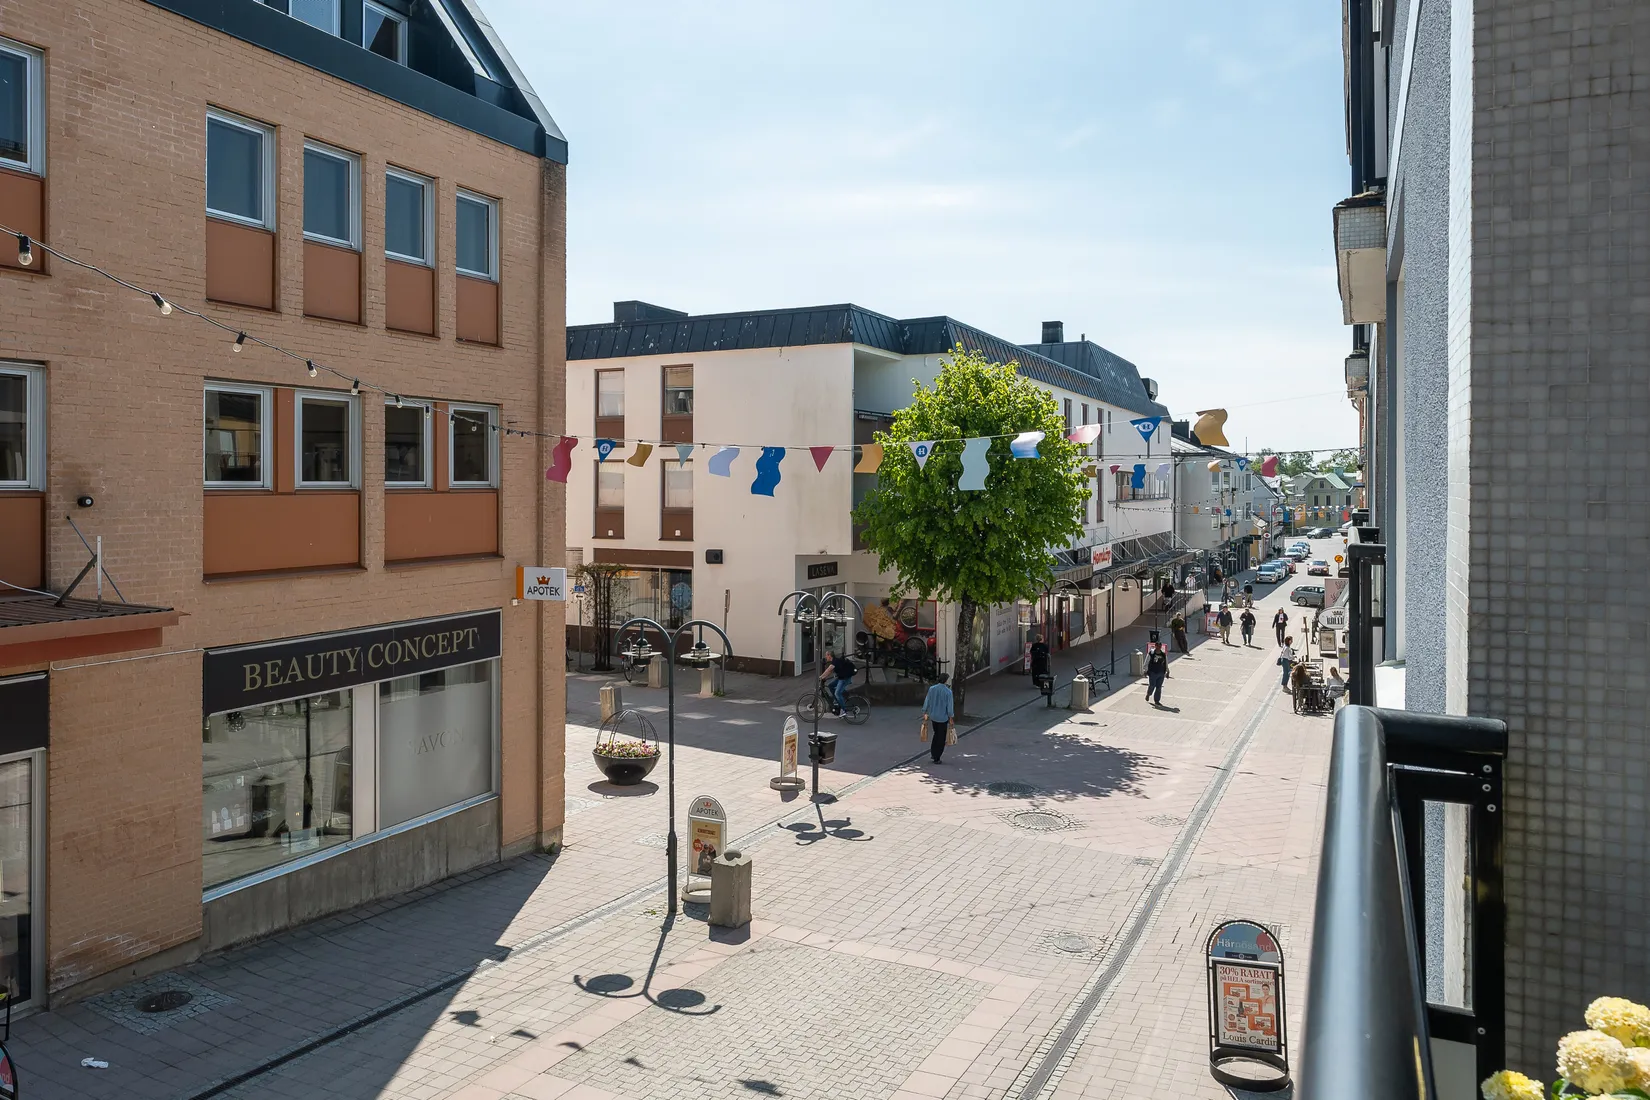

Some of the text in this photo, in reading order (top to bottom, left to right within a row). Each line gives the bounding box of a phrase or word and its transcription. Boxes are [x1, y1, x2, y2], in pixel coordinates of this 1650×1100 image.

[526, 585, 561, 597] APOTEK
[242, 627, 478, 692] BEAUTY CONCEPT
[695, 807, 720, 817] APOTEK
[1216, 937, 1272, 952] Härnösand
[1219, 966, 1239, 977] 30%
[1222, 1031, 1247, 1043] Louis
